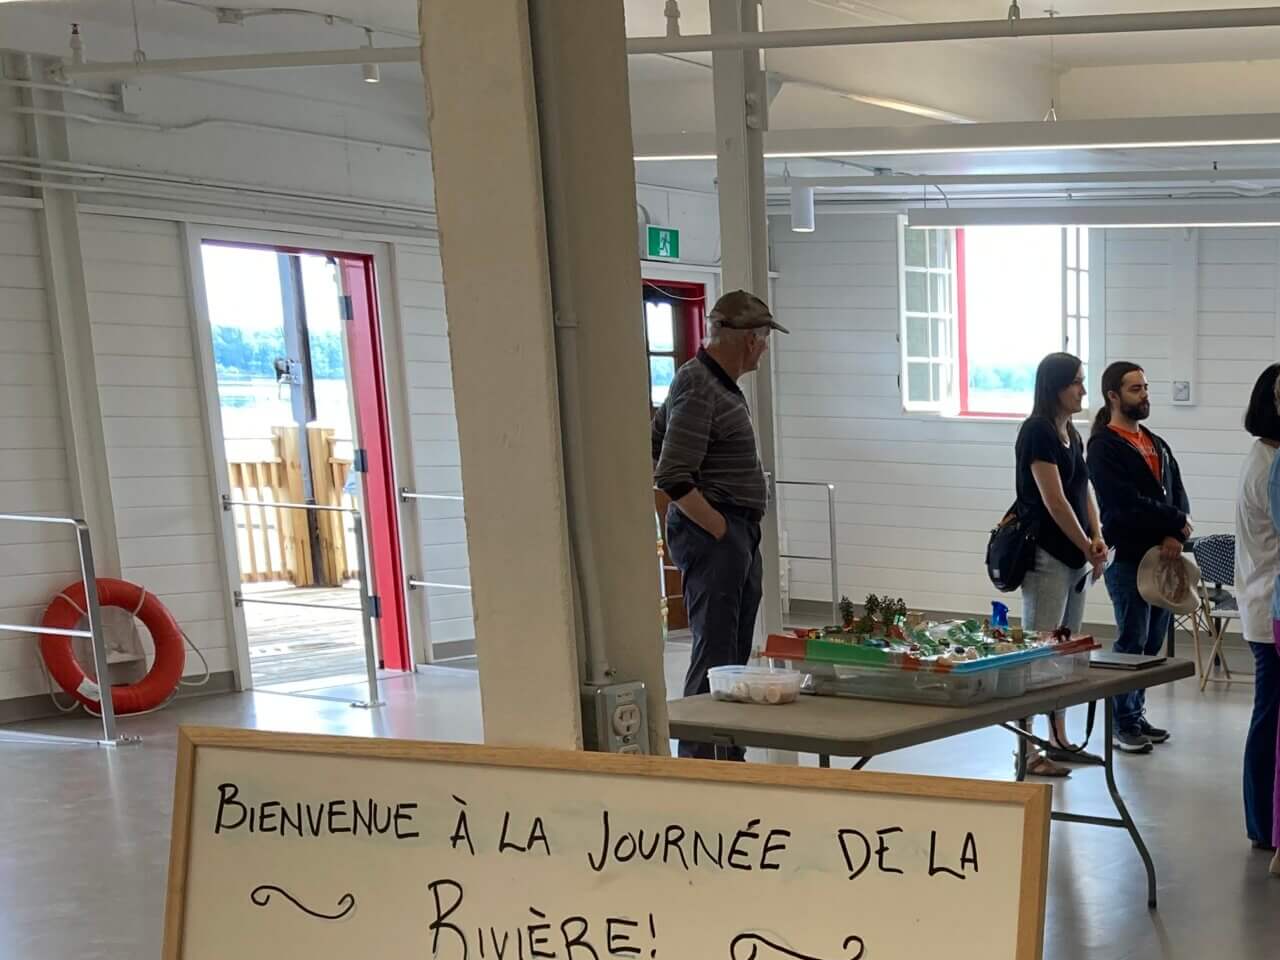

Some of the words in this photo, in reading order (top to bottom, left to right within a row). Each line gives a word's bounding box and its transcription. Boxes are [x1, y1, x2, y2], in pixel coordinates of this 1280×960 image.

[214, 782, 420, 840] BIENVENUE
[449, 794, 475, 857] À
[498, 811, 551, 856] LA
[587, 810, 792, 872] JOURNÉE
[837, 826, 904, 881] DE
[927, 830, 979, 880] LA
